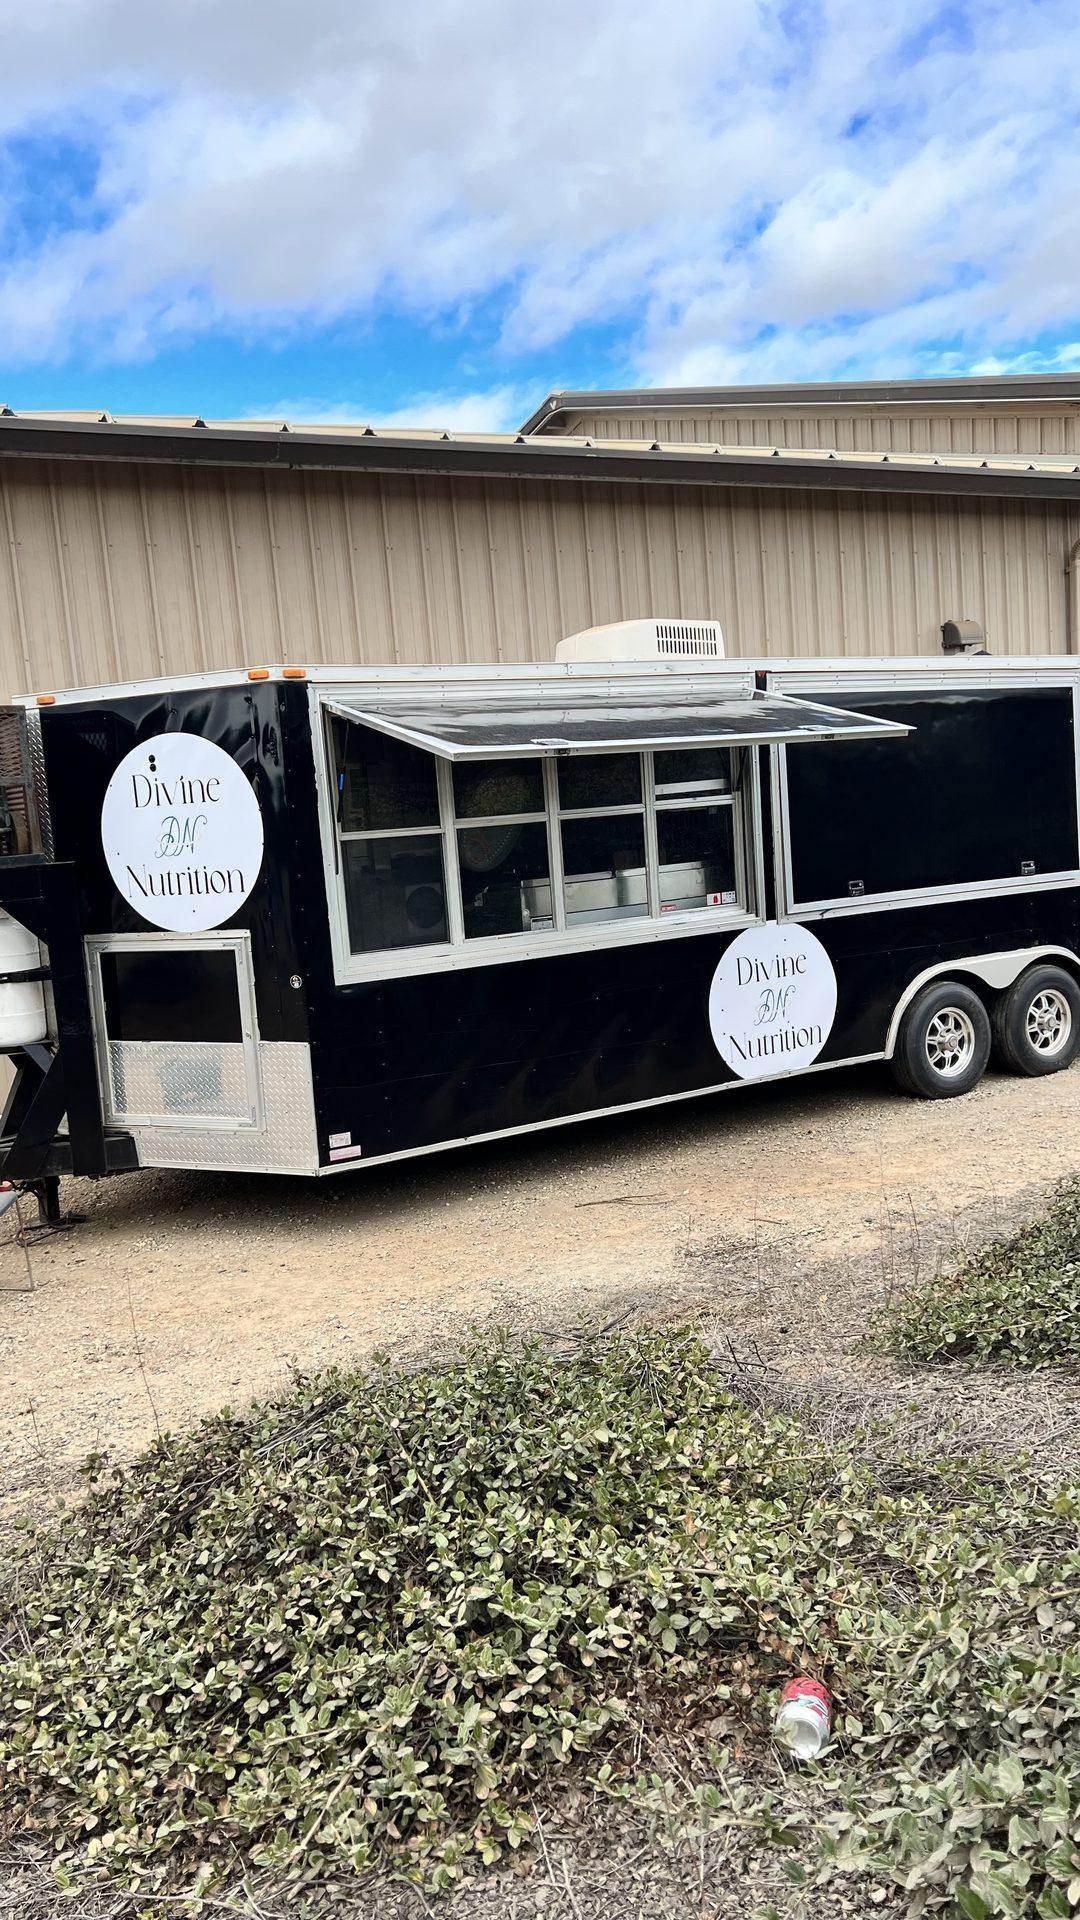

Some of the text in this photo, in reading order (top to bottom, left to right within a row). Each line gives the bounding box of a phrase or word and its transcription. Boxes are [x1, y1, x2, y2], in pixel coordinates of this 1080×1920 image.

[132, 774, 220, 808] Divine
[127, 864, 246, 898] Nutrition
[736, 954, 807, 986] Divine
[729, 1023, 822, 1063] Nutrition
